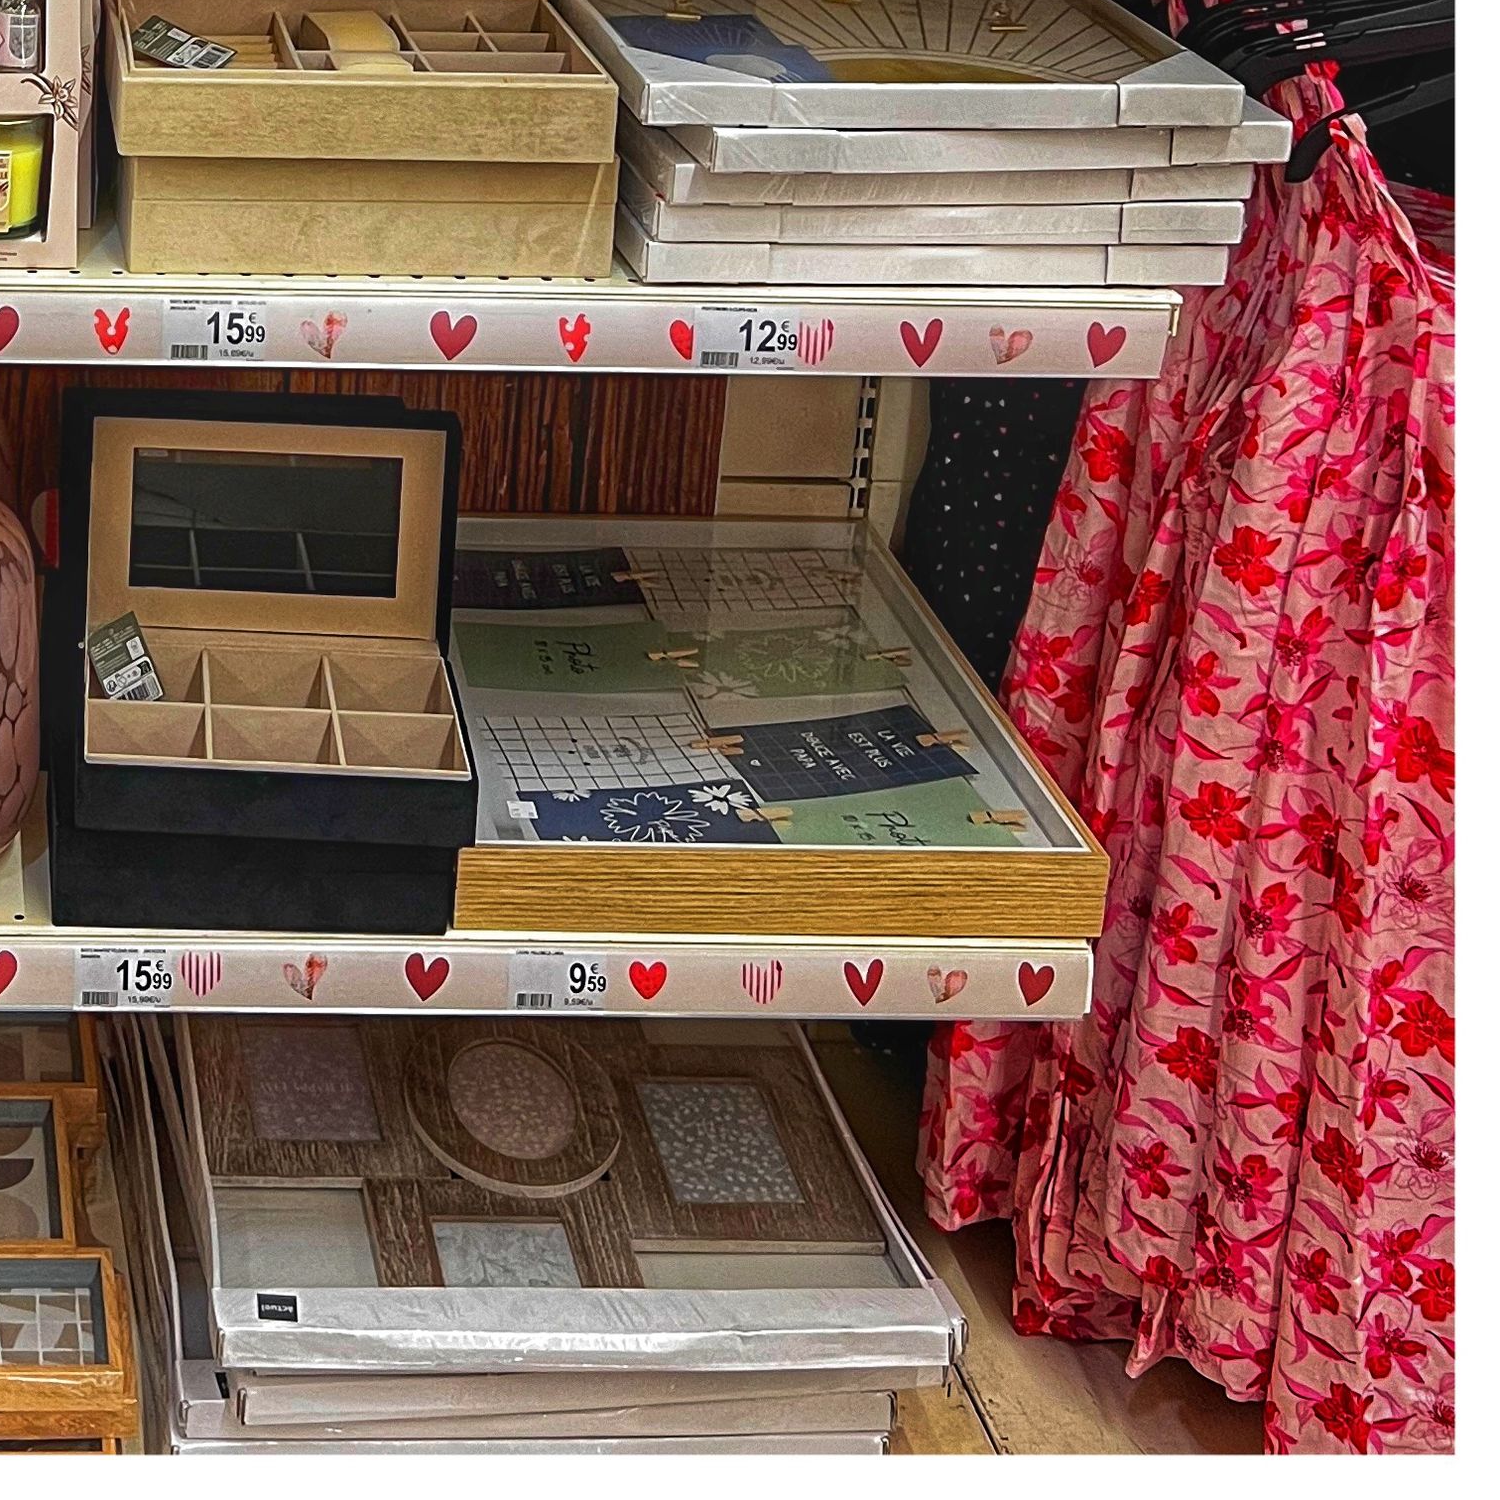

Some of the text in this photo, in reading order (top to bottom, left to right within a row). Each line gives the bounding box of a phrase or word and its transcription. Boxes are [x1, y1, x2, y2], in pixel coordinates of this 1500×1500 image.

[790, 748, 817, 769] PAPA
[800, 731, 856, 781] DOUCE AVEC
[847, 732, 893, 768] EST PLUS
[877, 729, 915, 758] LA VIE
